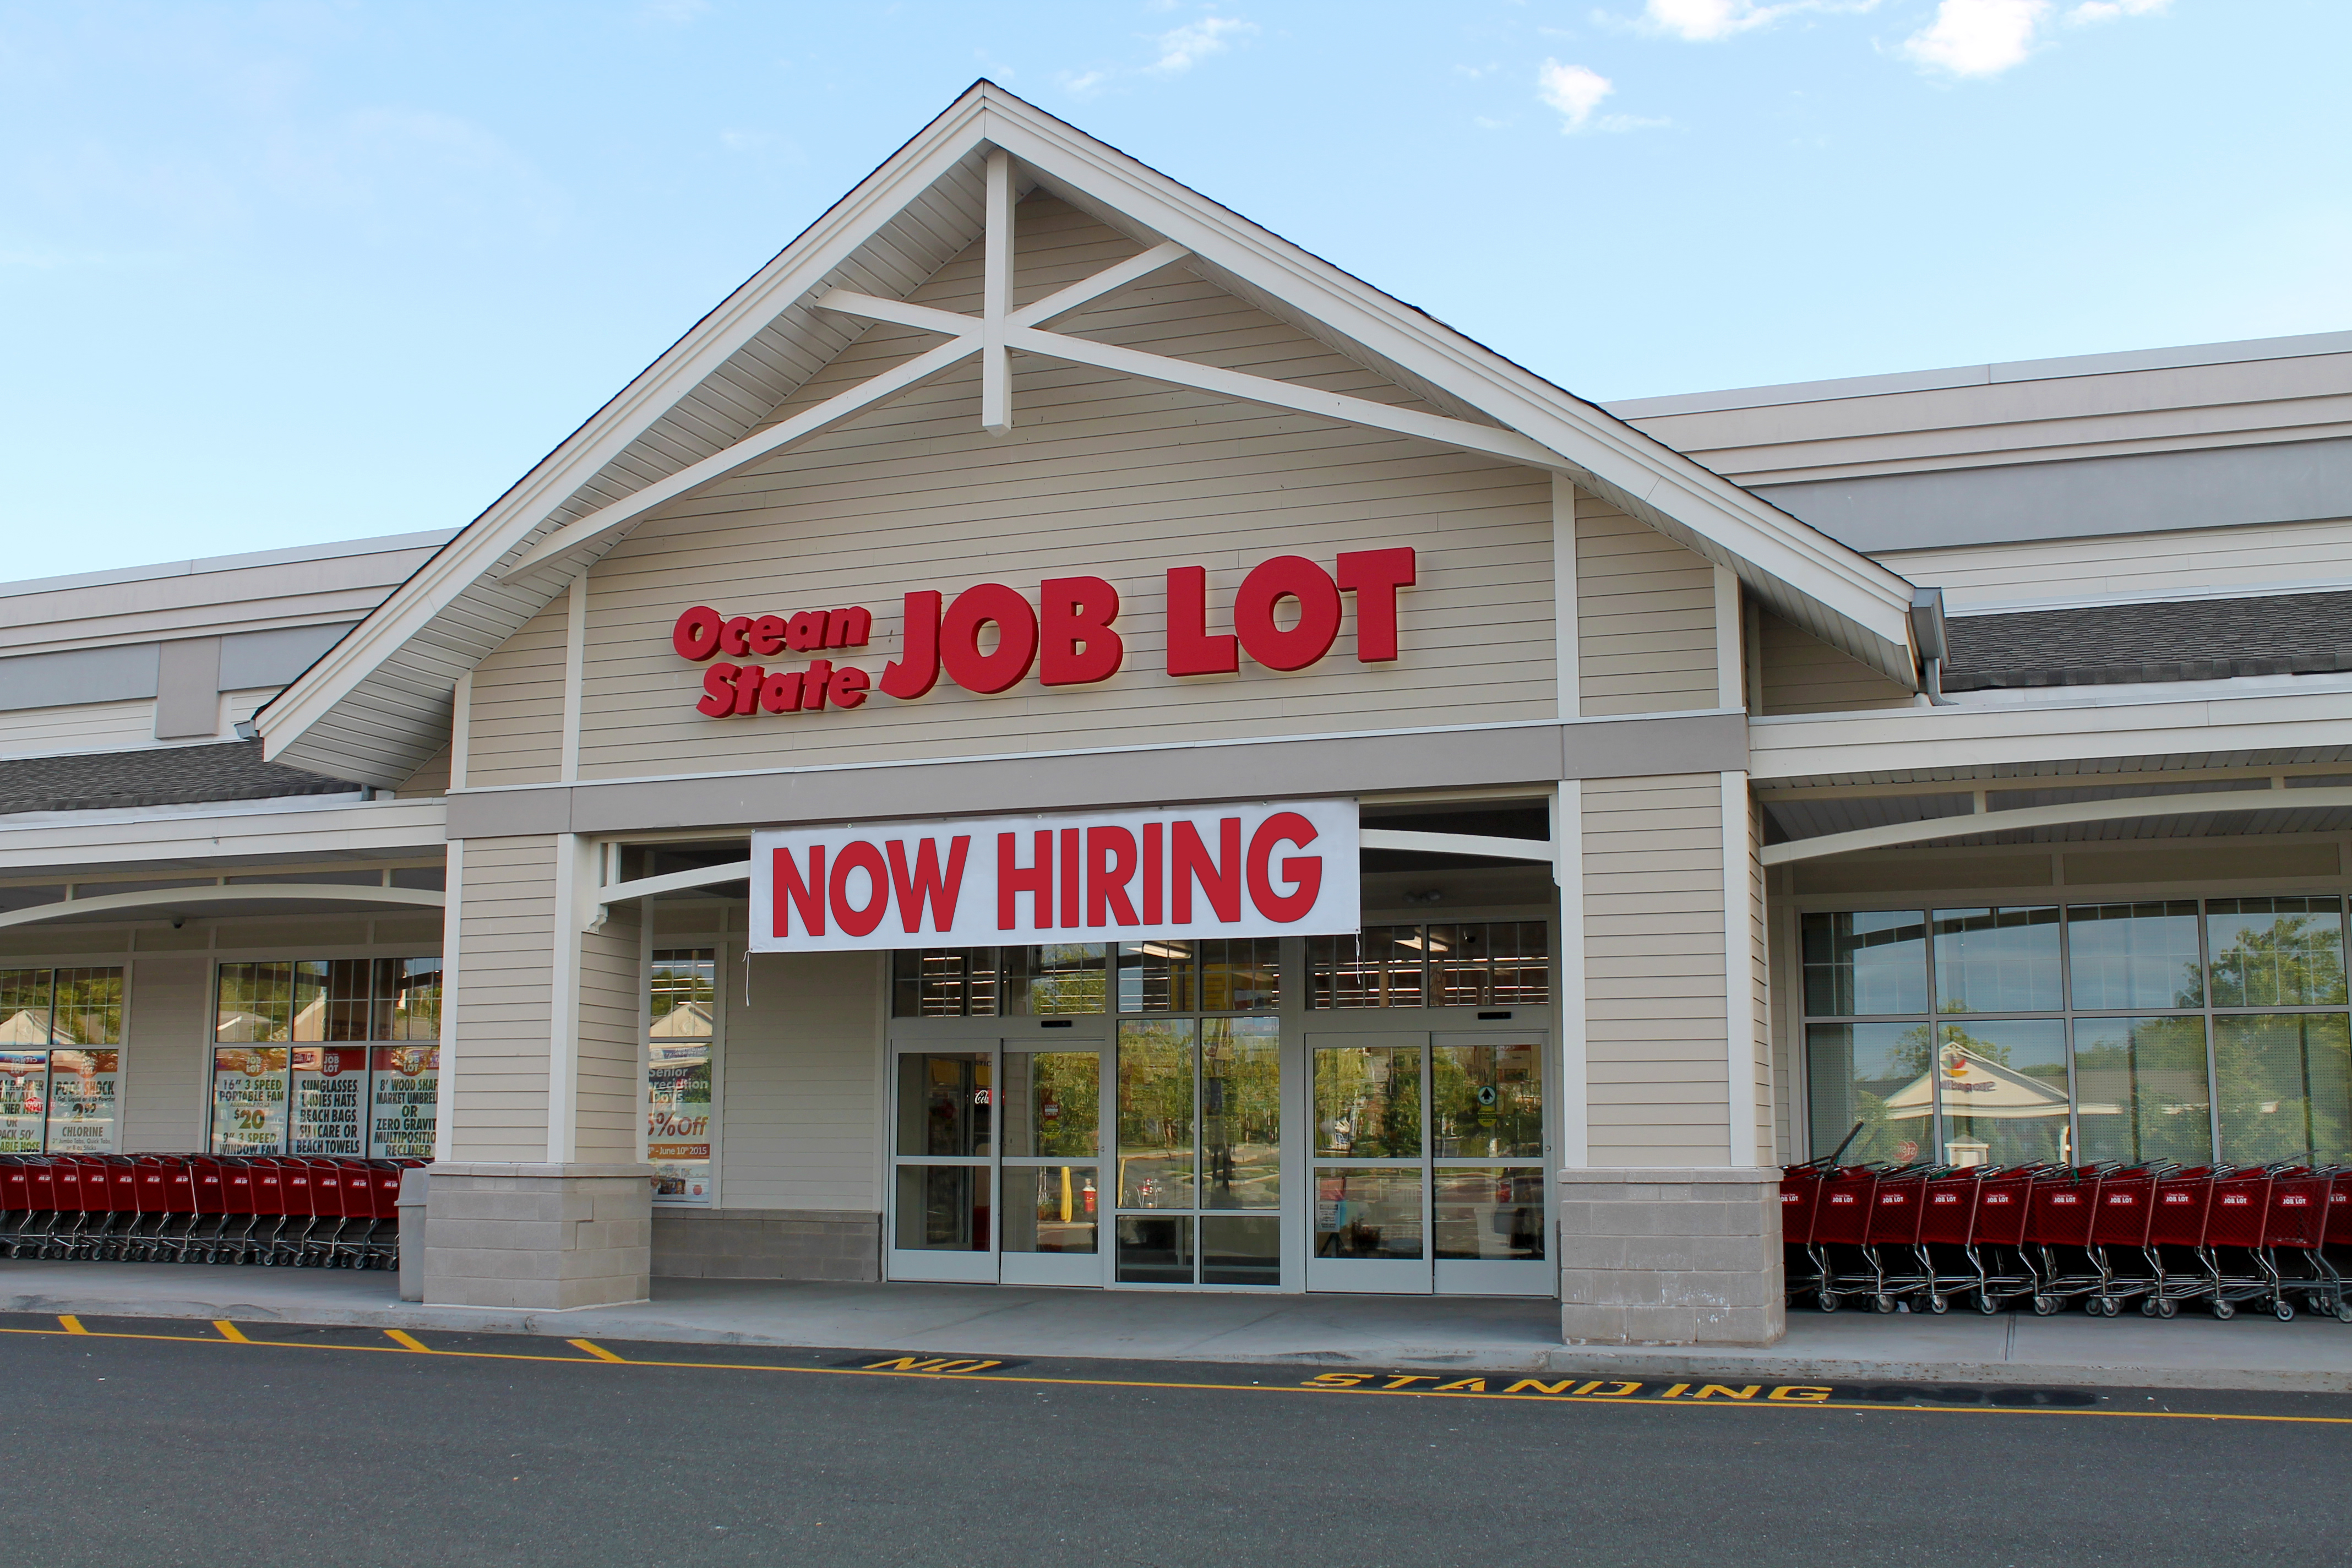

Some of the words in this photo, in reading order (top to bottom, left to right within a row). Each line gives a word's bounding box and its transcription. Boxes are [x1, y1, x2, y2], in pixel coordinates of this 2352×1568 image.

[878, 576, 1123, 699] JOB
[1167, 547, 1415, 677] LOT
[672, 606, 872, 661] Ocean
[696, 659, 870, 718] State
[772, 835, 971, 937] NOW
[997, 812, 1321, 930] HIRING
[324, 1056, 339, 1064] JOB
[246, 1065, 262, 1073] LOT
[403, 1064, 419, 1072] LOT
[649, 1068, 688, 1077] Senior
[244, 1080, 251, 1090] 3
[254, 1079, 282, 1090] SPEED
[302, 1079, 359, 1093] SUNGLASSES,
[391, 1079, 416, 1091] WOOD
[220, 1091, 264, 1102] PORTABLE
[267, 1091, 284, 1102] FAN
[301, 1093, 332, 1107] LADIES
[333, 1093, 358, 1107] HATS,
[376, 1092, 406, 1104] MARKET
[300, 1109, 329, 1123] BEACH
[331, 1109, 358, 1123] BAGS,
[401, 1106, 418, 1117] OR
[234, 1108, 265, 1129] $20
[376, 1119, 400, 1130] ZERO
[62, 1126, 104, 1137] CHLORINE
[344, 1124, 357, 1138] OR
[238, 1133, 244, 1143] 3
[248, 1133, 277, 1144] SPEED
[220, 1144, 258, 1155] WINDOW
[261, 1145, 279, 1155] FAN
[296, 1140, 324, 1153] BEACH
[325, 1140, 360, 1153] TOWELS
[385, 1145, 432, 1157] RECLINER
[660, 1147, 676, 1155] June
[862, 1357, 1002, 1373] NO
[1300, 1373, 1834, 1401] STANDING
